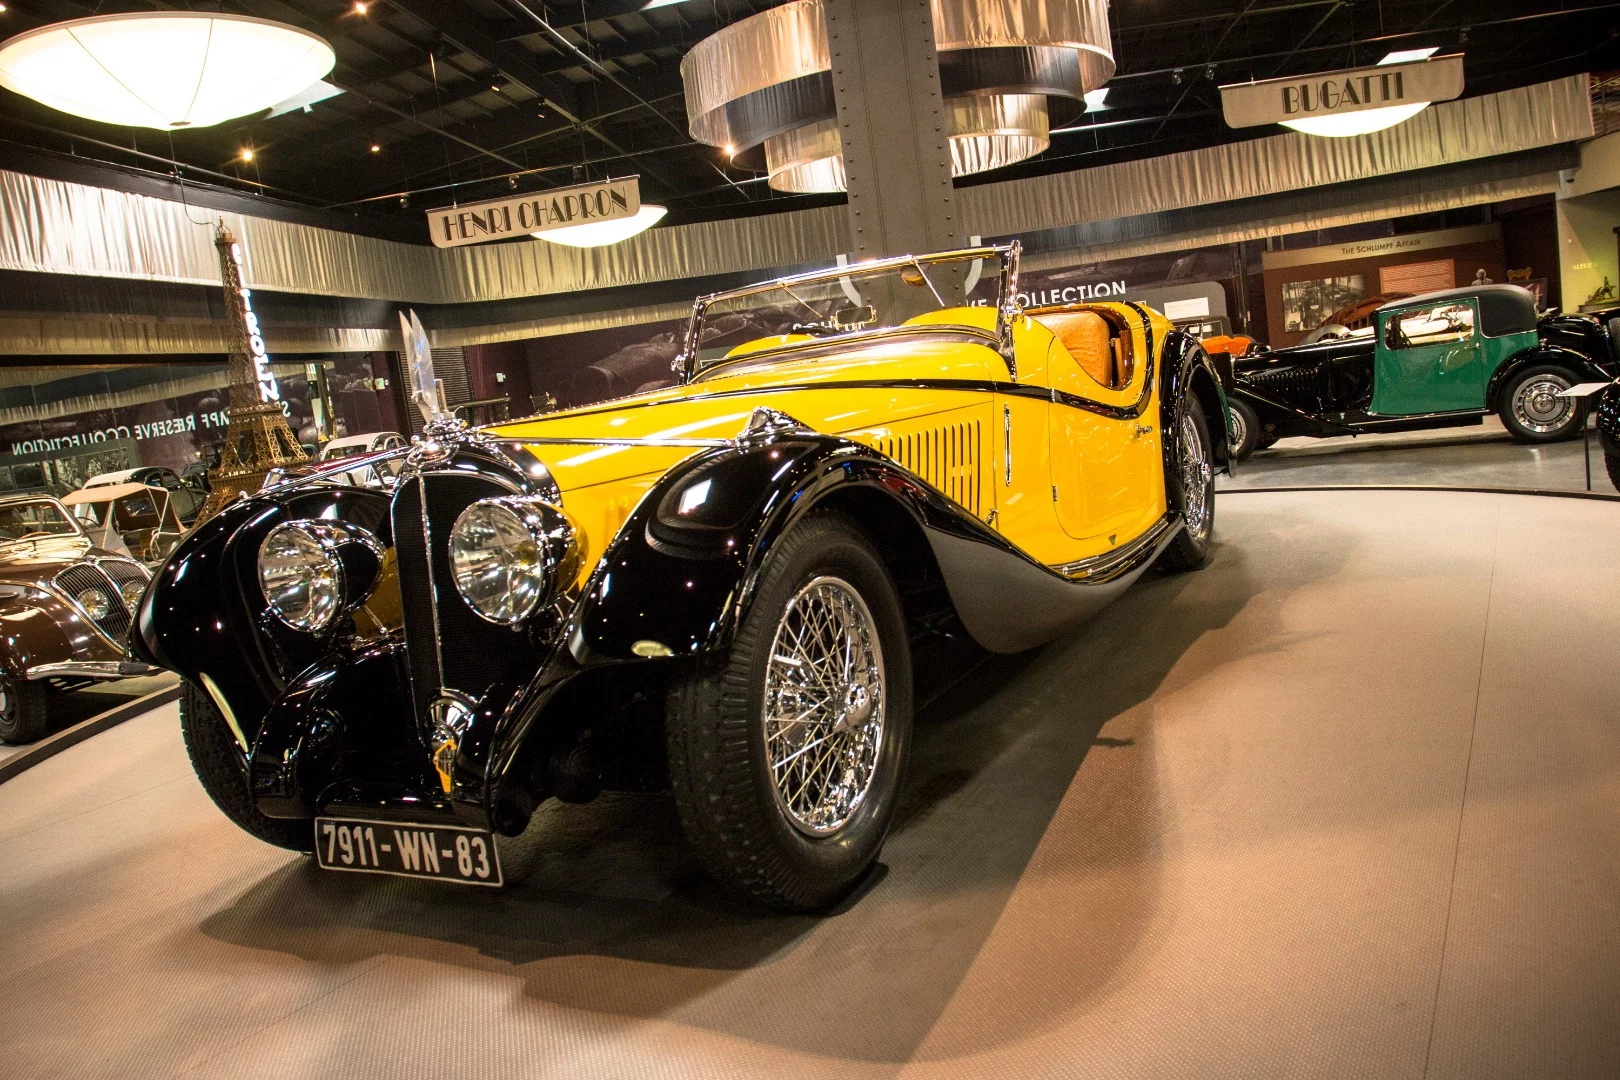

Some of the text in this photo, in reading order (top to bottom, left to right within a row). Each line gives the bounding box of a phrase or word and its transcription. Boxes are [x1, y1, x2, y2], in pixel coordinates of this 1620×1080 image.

[1281, 71, 1404, 115] BUGATTI
[442, 186, 628, 241] HENRI CHAPRON
[1356, 242, 1393, 253] SCHLUMPF
[1396, 239, 1421, 248] AFFAIR
[997, 280, 1126, 308] OLLECTION
[323, 825, 490, 879] 7911-WN-83
